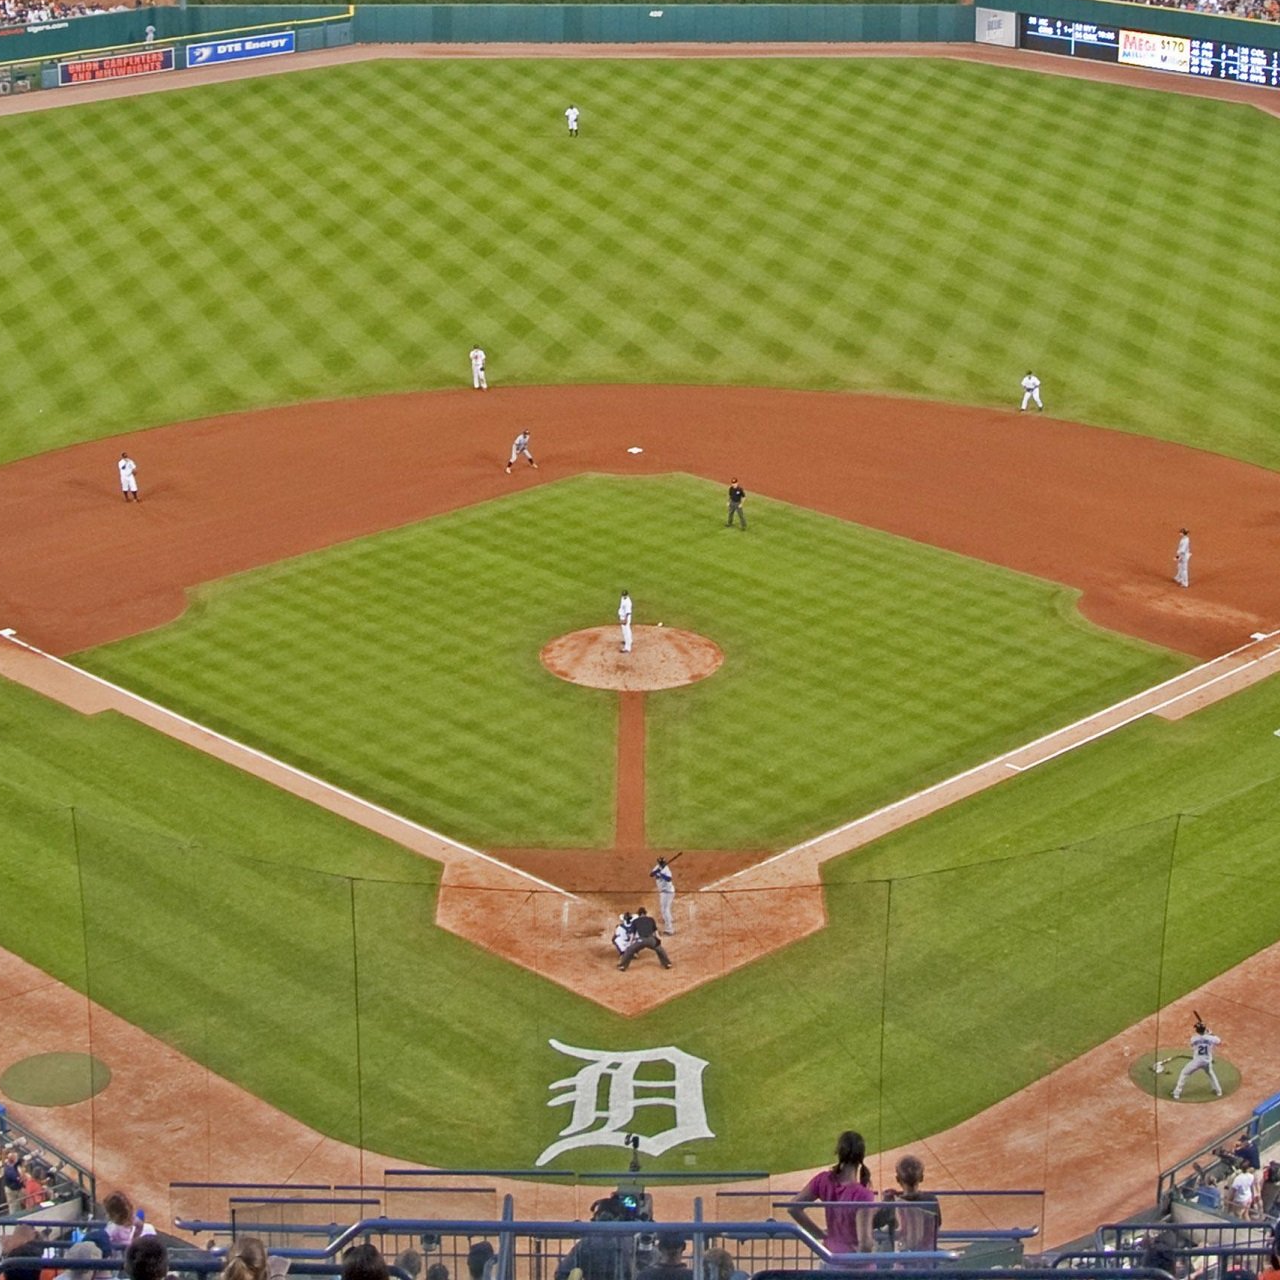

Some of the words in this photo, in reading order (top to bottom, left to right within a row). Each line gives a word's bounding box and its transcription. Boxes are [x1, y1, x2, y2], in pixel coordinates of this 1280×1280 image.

[217, 43, 244, 55] DTE
[245, 37, 289, 51] Energy
[68, 61, 100, 74] UNION
[103, 52, 165, 70] CARPENTERS
